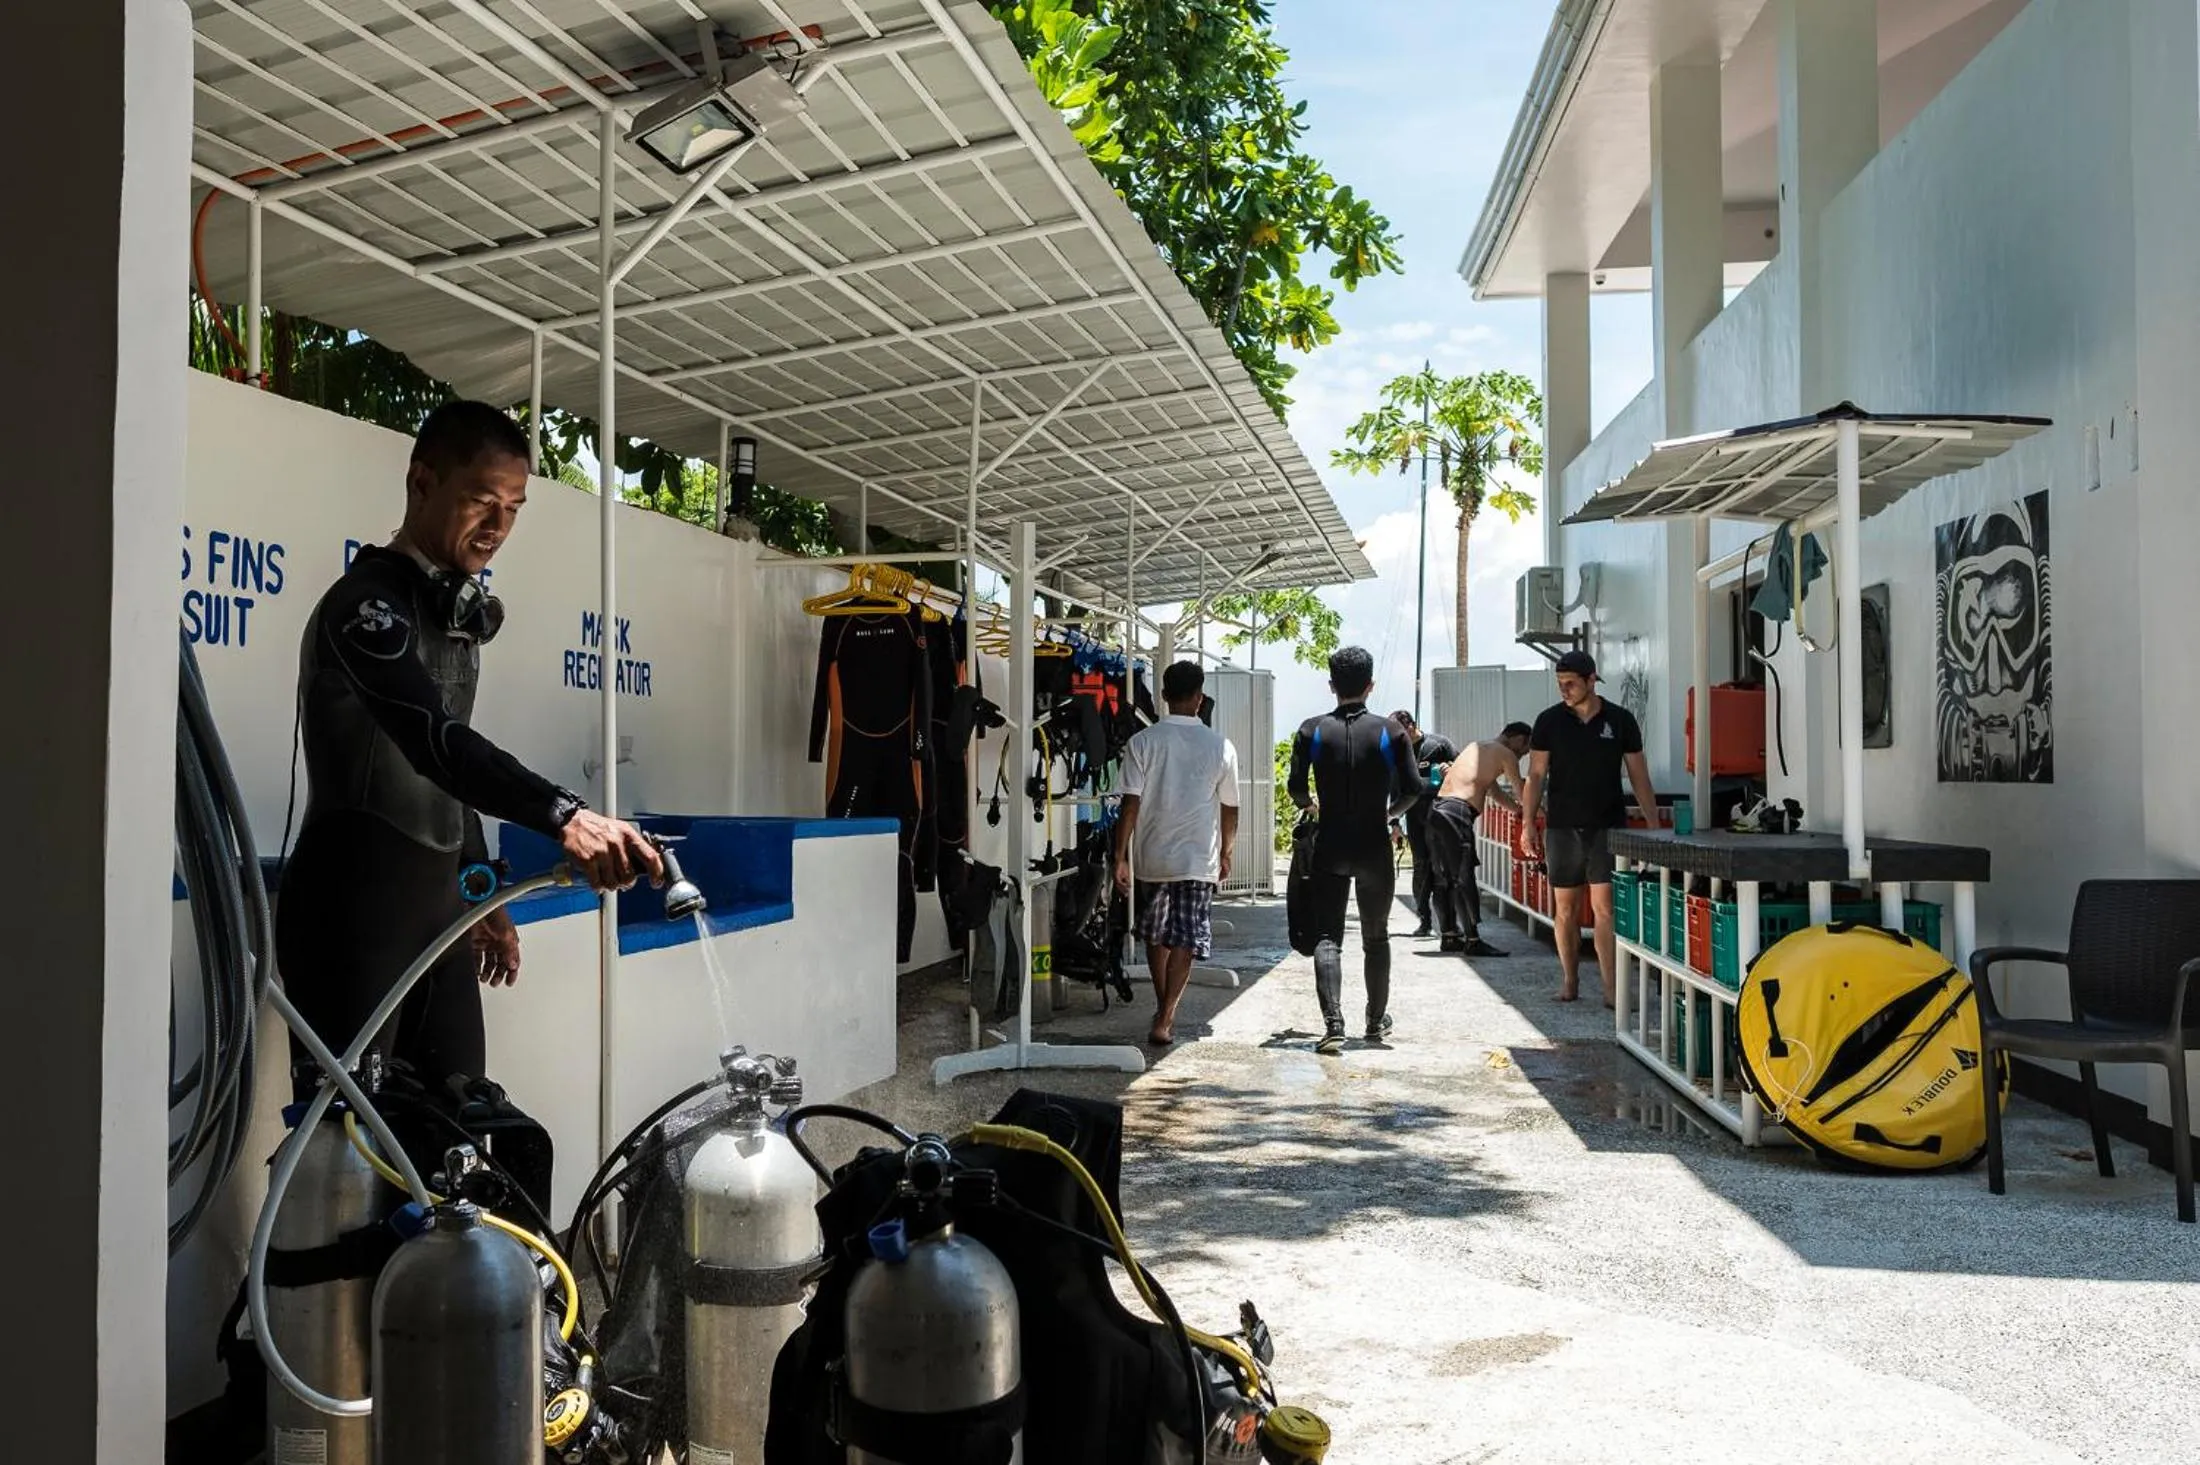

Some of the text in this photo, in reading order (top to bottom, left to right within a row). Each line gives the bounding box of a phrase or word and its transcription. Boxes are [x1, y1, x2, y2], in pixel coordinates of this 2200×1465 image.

[208, 530, 285, 595] FINS
[182, 589, 255, 647] SUIT
[563, 648, 652, 697] REGATOR
